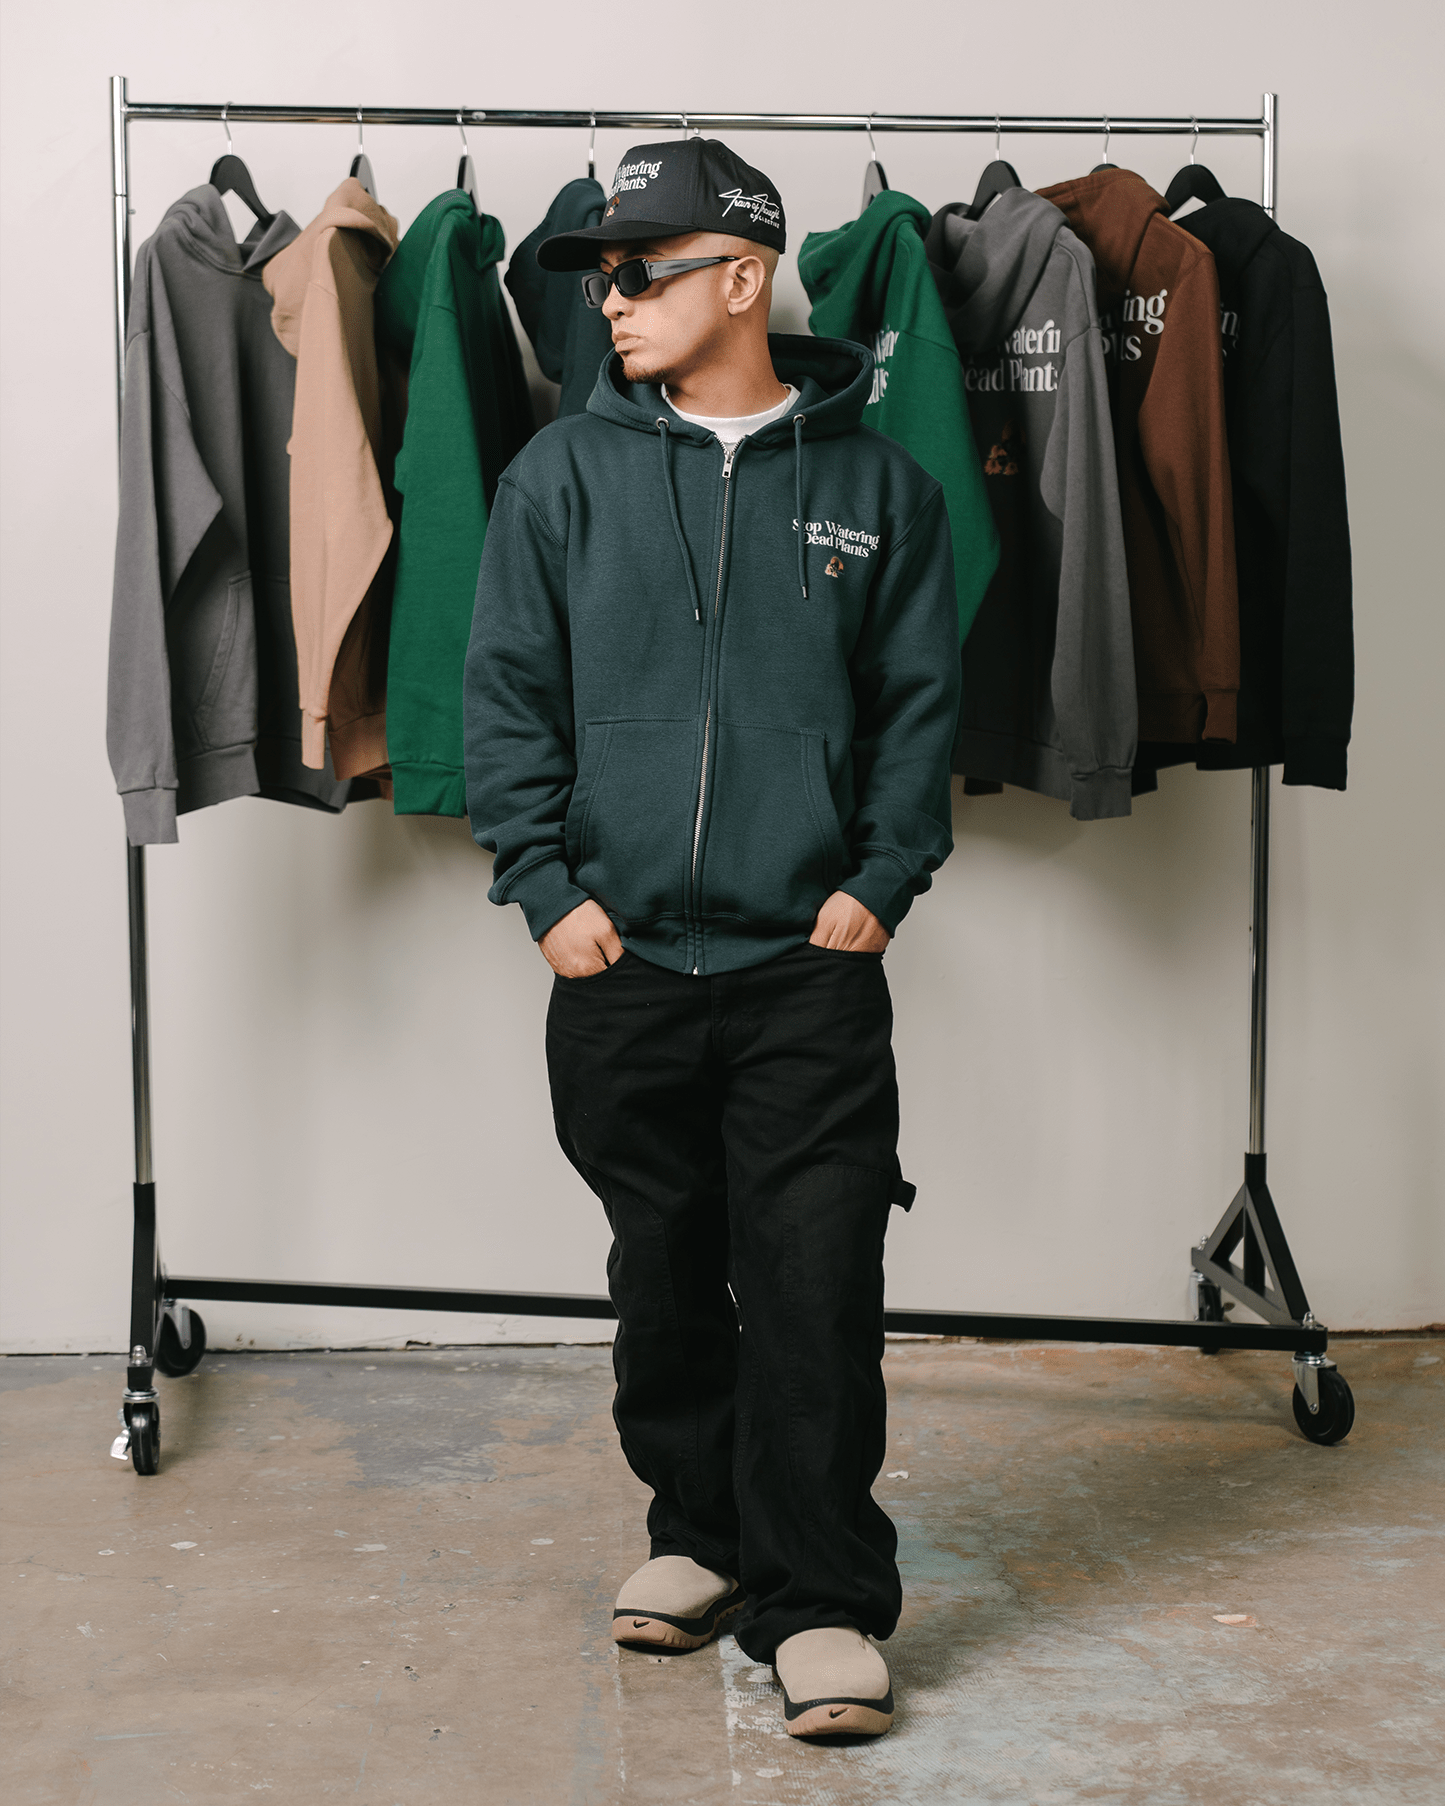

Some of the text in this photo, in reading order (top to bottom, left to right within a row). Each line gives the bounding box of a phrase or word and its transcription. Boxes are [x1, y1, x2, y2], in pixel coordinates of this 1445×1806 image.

[965, 358, 1005, 392] ead
[792, 518, 880, 550] Sop Watering
[835, 535, 869, 557] Plants
